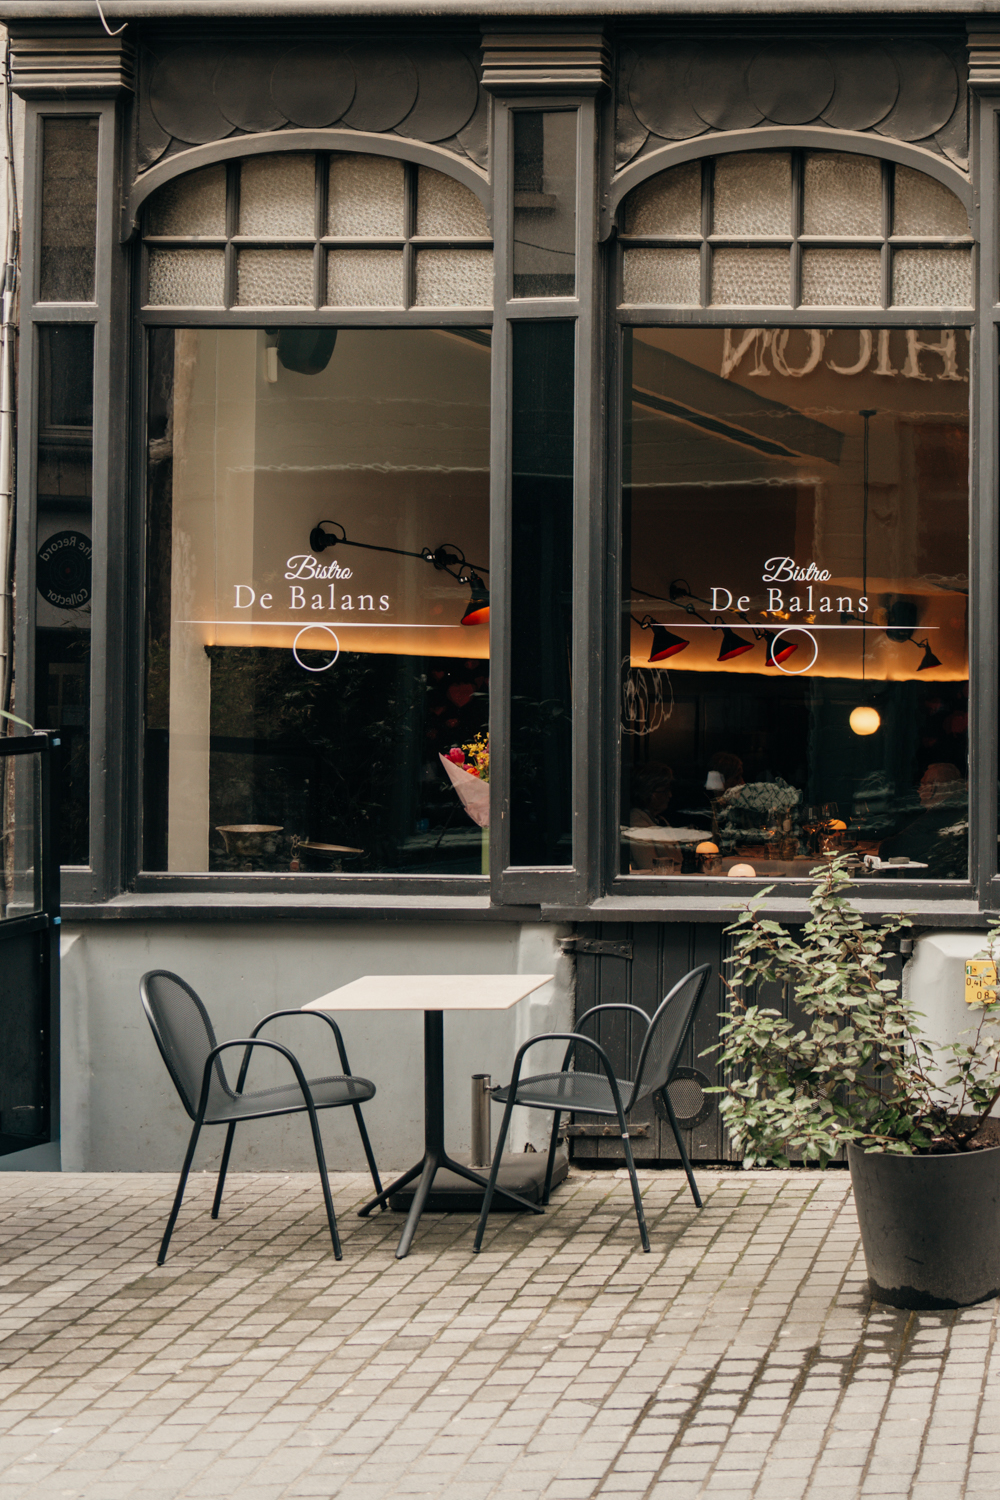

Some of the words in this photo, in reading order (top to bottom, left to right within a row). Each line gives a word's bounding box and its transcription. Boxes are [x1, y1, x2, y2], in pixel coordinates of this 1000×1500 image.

[284, 554, 354, 580] Bistro
[762, 556, 832, 583] Bistro
[233, 584, 273, 610] De
[288, 583, 390, 612] Balans
[709, 586, 751, 612] De
[766, 585, 869, 613] Balans
